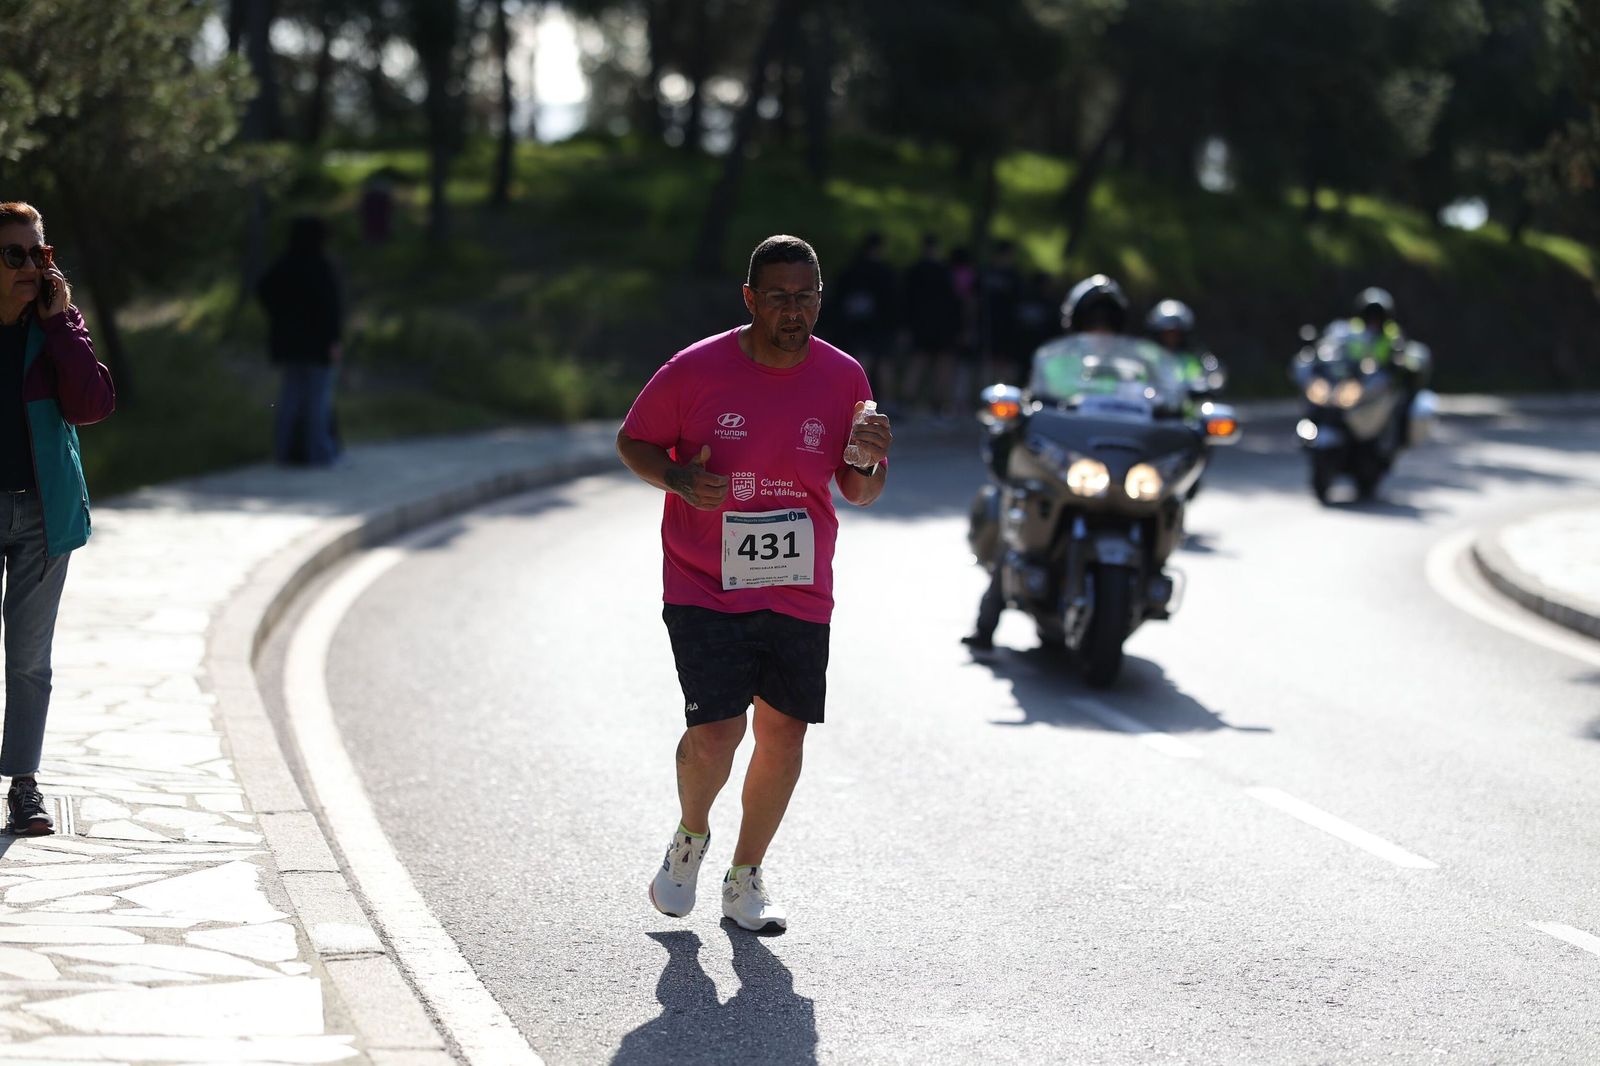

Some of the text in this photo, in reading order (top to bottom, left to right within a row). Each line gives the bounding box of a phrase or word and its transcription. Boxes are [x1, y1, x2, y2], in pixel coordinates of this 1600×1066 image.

[714, 429, 748, 437] HYUNDAI
[760, 478, 794, 488] Ciudad
[760, 488, 808, 498] de Málaga
[738, 531, 800, 561] 431
